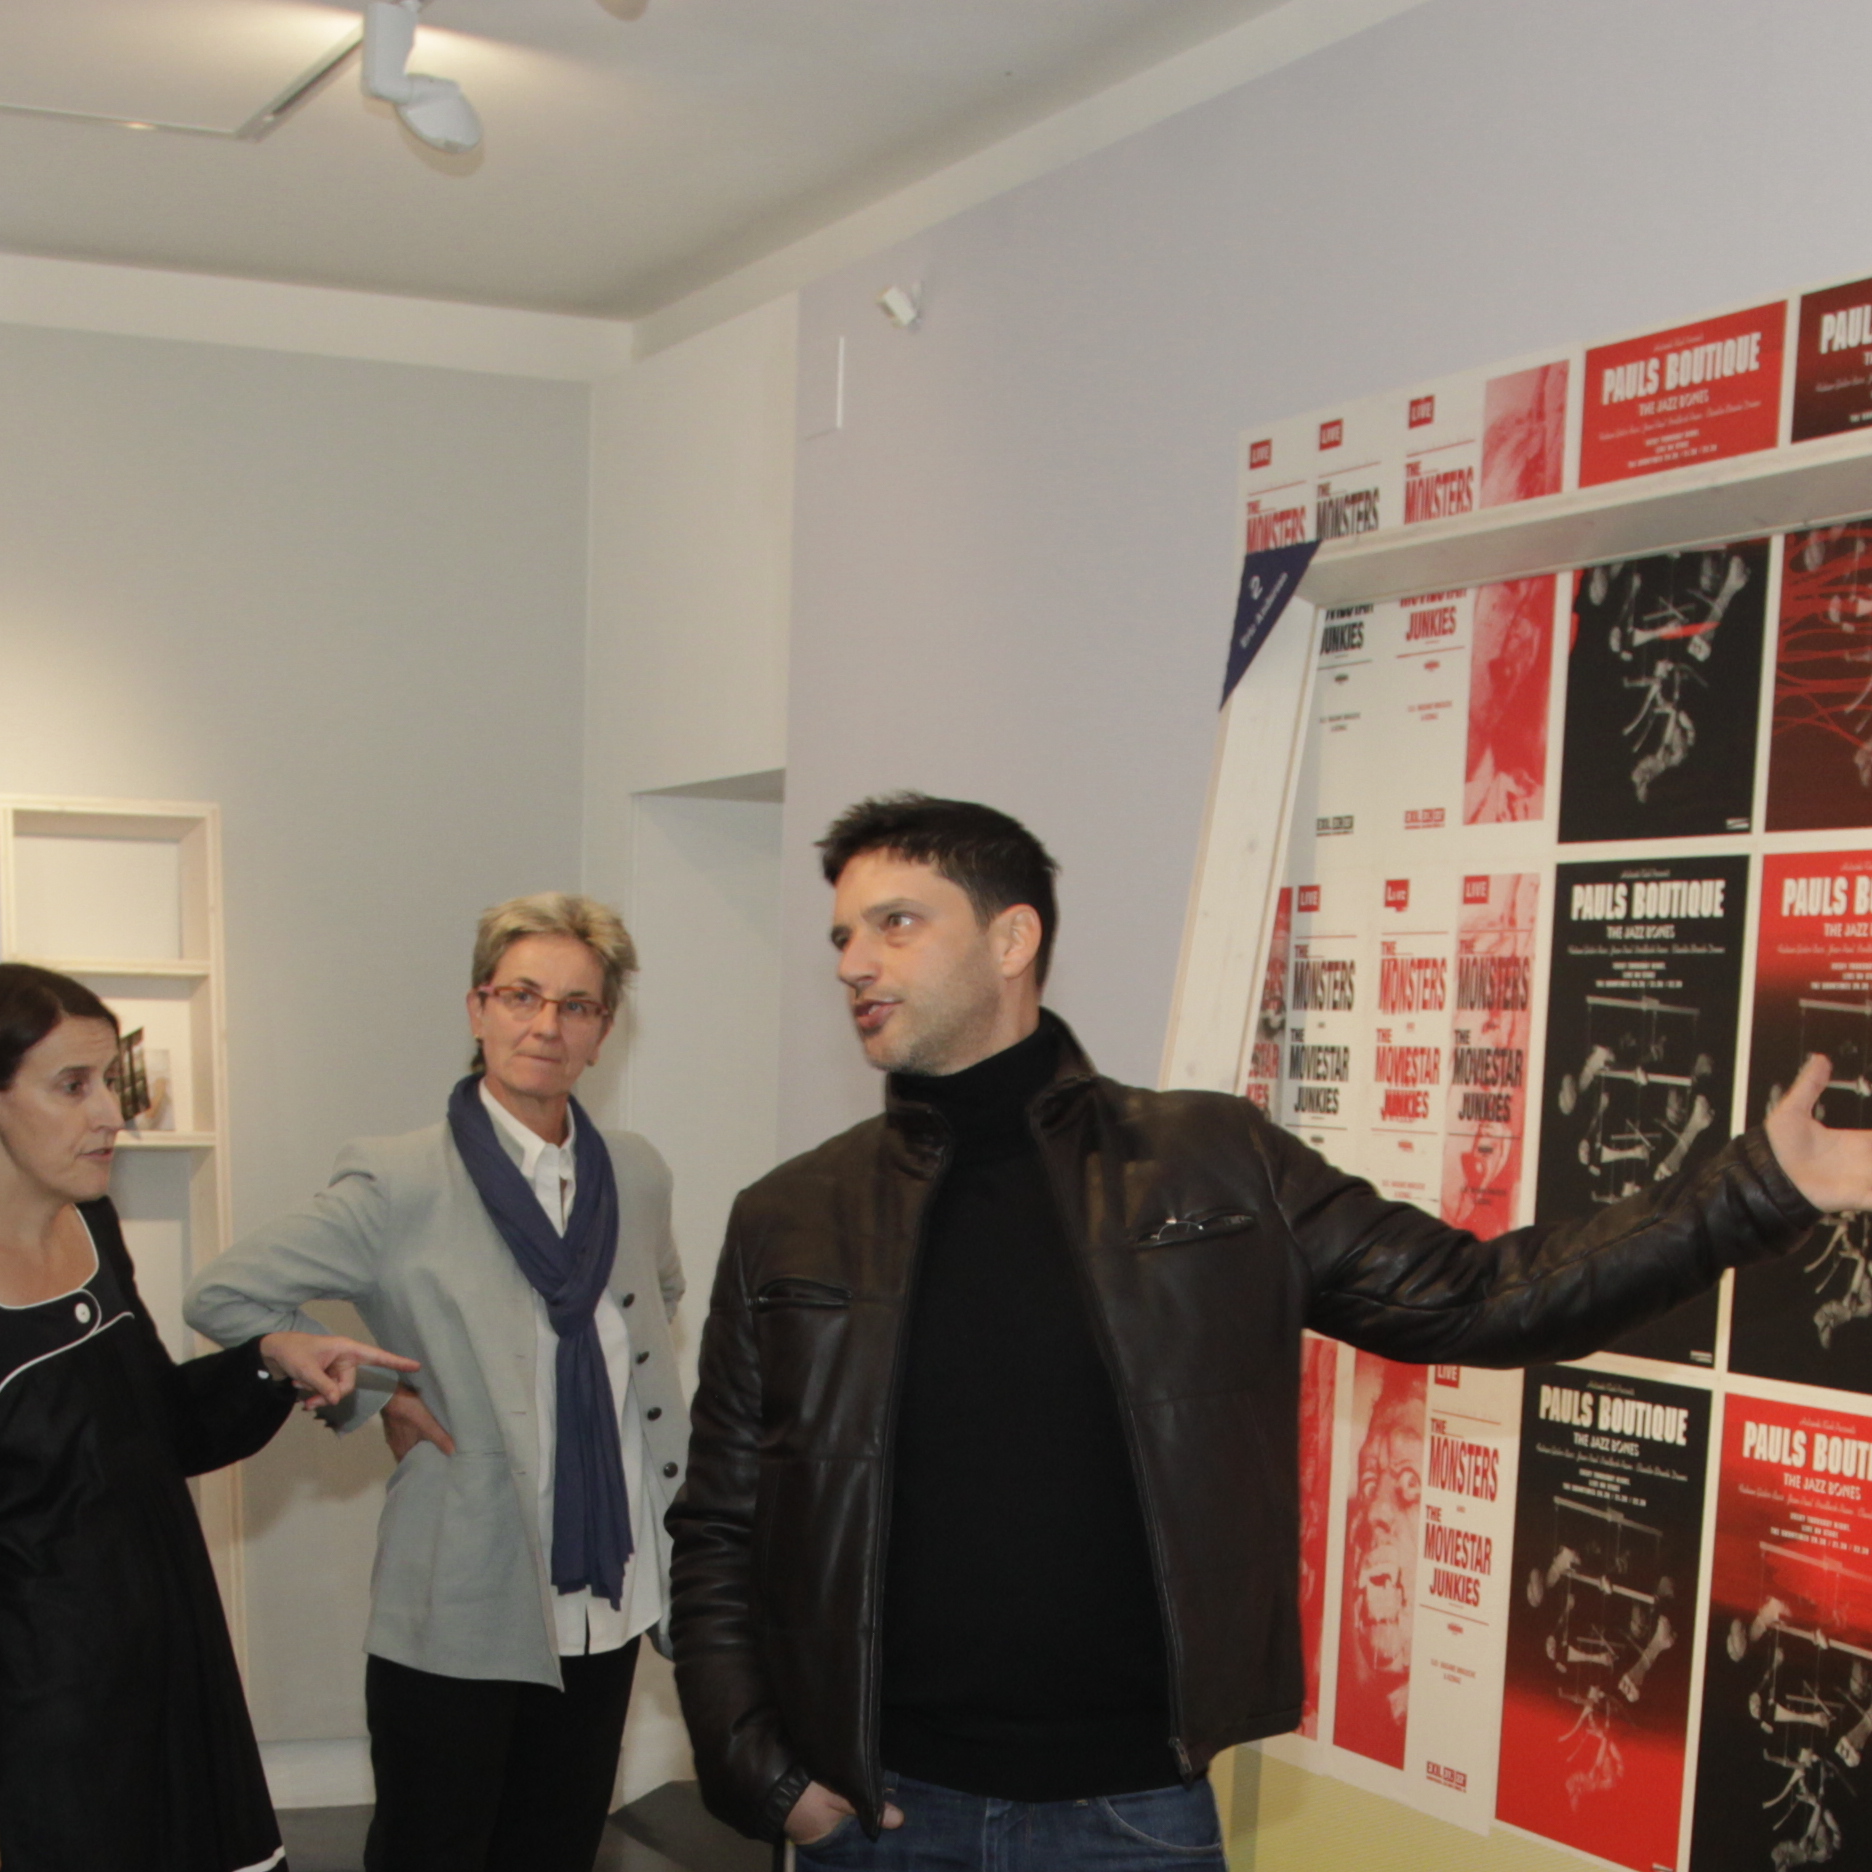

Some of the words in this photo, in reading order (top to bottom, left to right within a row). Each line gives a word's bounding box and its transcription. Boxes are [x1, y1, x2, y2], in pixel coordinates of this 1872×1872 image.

[1602, 358, 1660, 405] PAULS
[1665, 332, 1761, 391] BOUTIQUE
[1316, 487, 1379, 541] MONSTERS
[1404, 466, 1474, 524] MONSTERS
[1249, 574, 1263, 601] 2
[1406, 606, 1457, 641] JUNKIES
[1571, 883, 1627, 921] PAULS
[1631, 879, 1726, 919] BOUTIQUE
[1782, 876, 1848, 917] PAULS
[1824, 923, 1842, 936] THE
[1844, 923, 1868, 936] JAZZ
[1295, 944, 1308, 958] THE
[1293, 960, 1355, 1011] MONSTERS
[1378, 957, 1447, 1015] MONSTERS
[1457, 956, 1530, 1011] MONSTERS
[1291, 1028, 1304, 1042] THE
[1376, 1028, 1392, 1043] THE
[1454, 1029, 1471, 1045] THE
[1289, 1045, 1349, 1082] MOVIESTAR
[1375, 1046, 1440, 1086] MOVIESTAR
[1452, 1048, 1523, 1087] MOVIESTAR
[1294, 1086, 1340, 1115] JUNKIES
[1457, 1092, 1512, 1122] JUNKIES
[1431, 1419, 1447, 1434] THE
[1539, 1384, 1594, 1428] PAULS
[1598, 1394, 1689, 1446] BOUTIQUE
[1743, 1421, 1806, 1468] PAULS
[1429, 1435, 1499, 1503] MONSTERS
[1784, 1473, 1801, 1488] THE
[1803, 1477, 1826, 1494] JAZZ
[1426, 1504, 1443, 1523] THE
[1424, 1522, 1492, 1576] MOVIESTAR
[1429, 1568, 1481, 1609] JUNKIES
